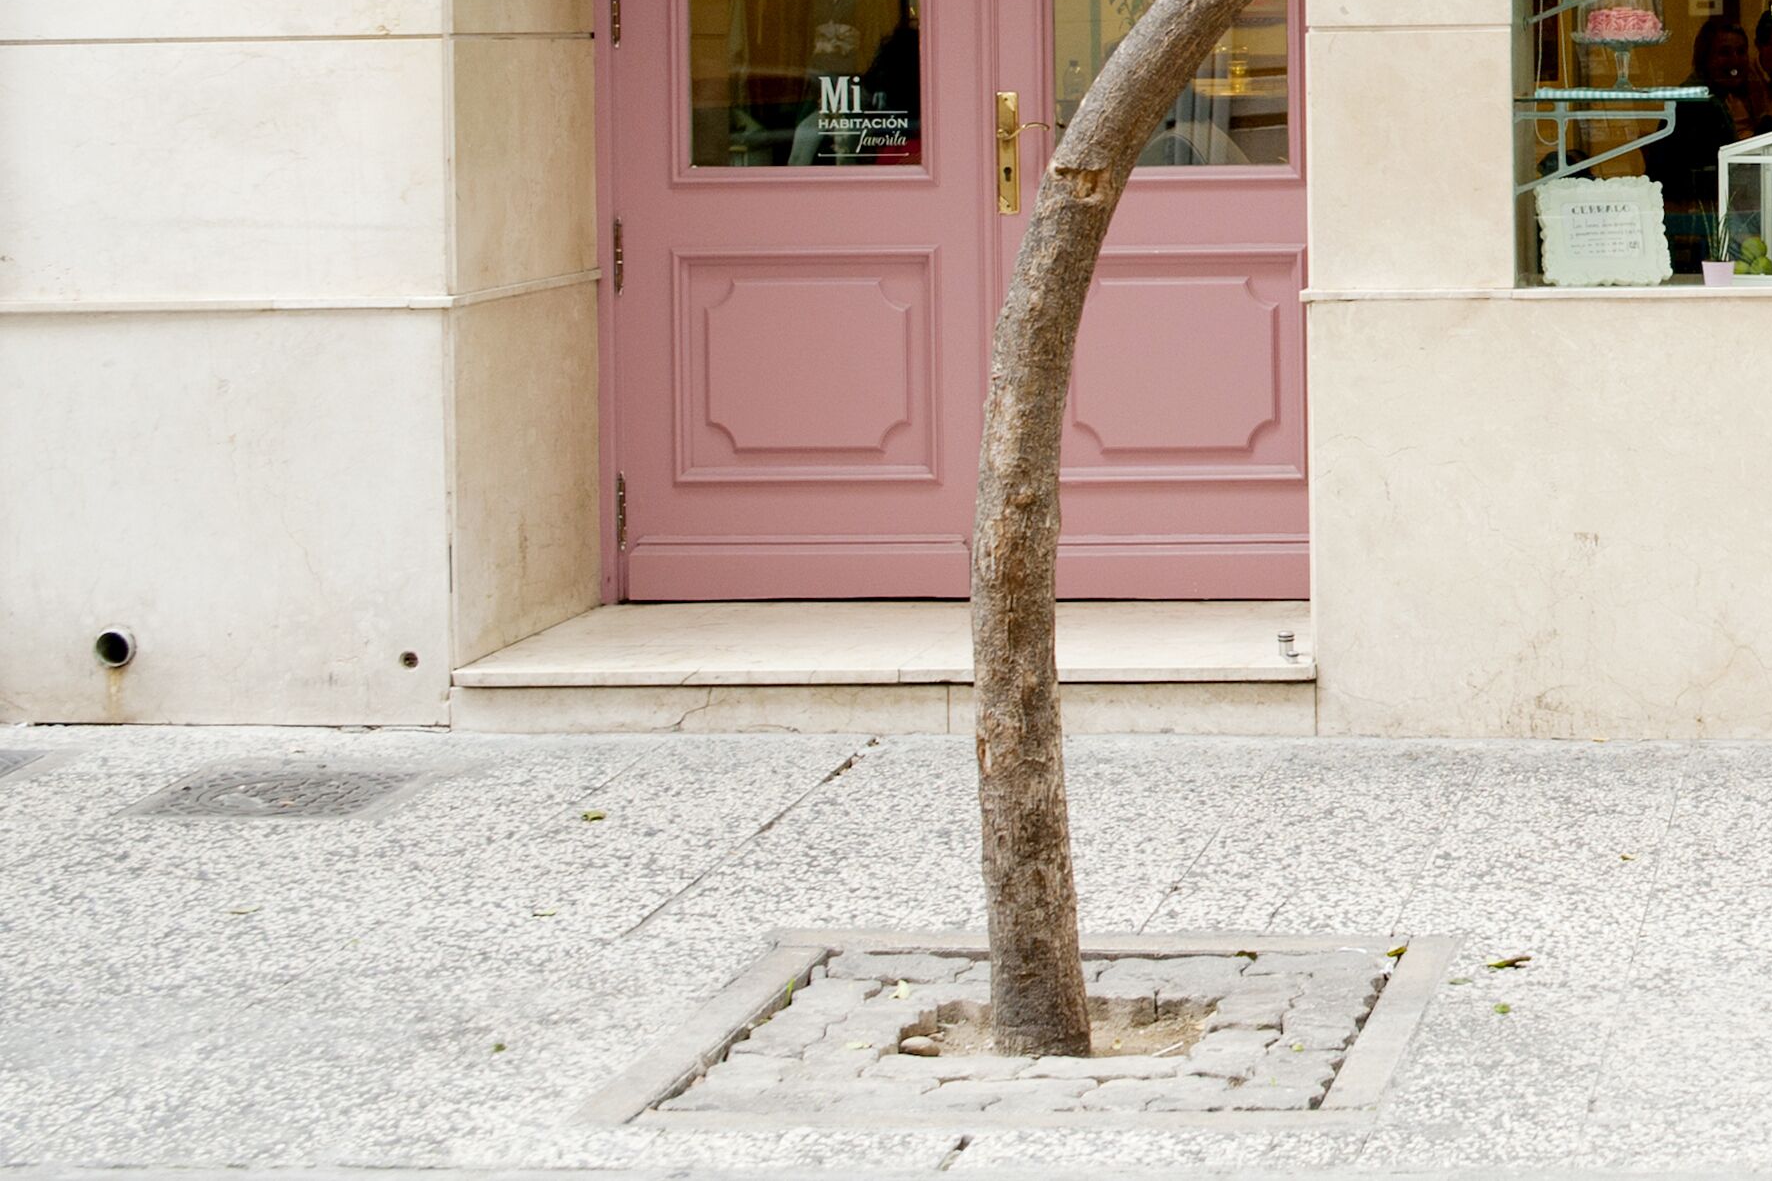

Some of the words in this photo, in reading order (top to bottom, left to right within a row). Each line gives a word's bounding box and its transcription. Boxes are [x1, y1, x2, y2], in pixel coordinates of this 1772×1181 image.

[818, 76, 863, 114] Mi
[818, 115, 908, 129] HABITACIÓN
[856, 129, 907, 153] favorita
